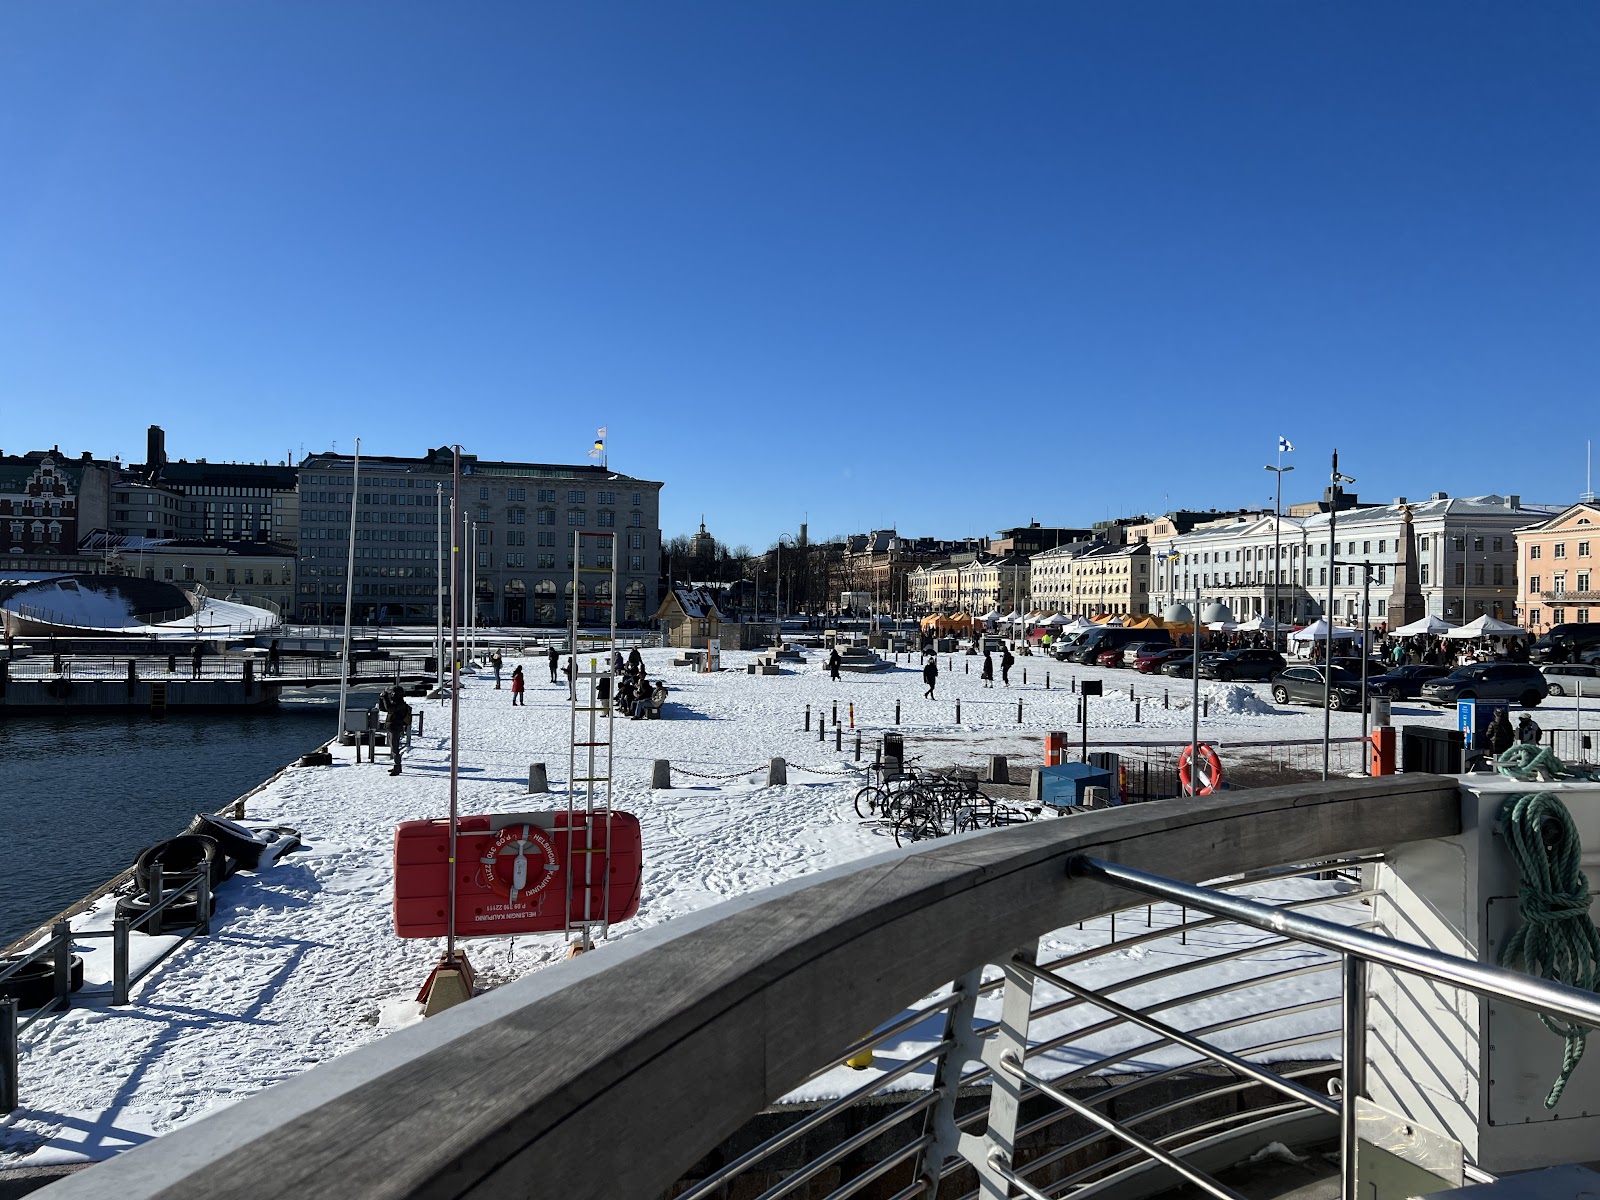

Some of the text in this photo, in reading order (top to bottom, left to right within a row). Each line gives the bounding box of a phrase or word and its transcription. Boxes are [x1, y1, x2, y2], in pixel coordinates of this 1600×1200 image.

[484, 834, 512, 882] P.09 310 22111
[525, 833, 556, 897] HELSINGIN KAUPUNKI
[475, 911, 537, 921] HELSINGIN KAUPUNKI
[486, 903, 503, 911] 22111
